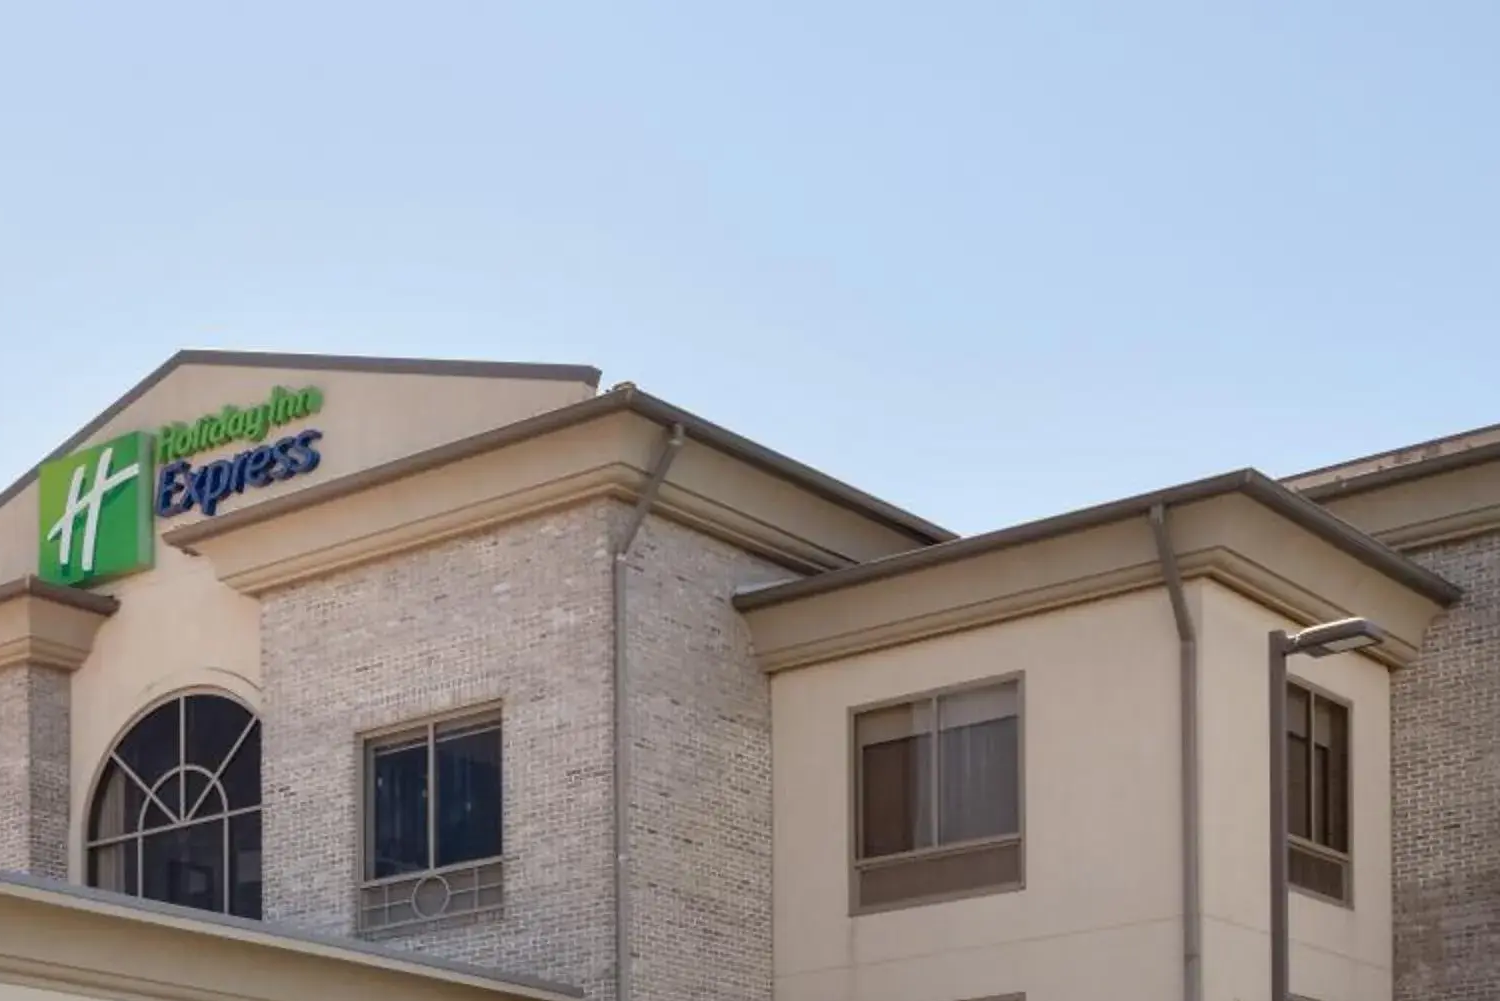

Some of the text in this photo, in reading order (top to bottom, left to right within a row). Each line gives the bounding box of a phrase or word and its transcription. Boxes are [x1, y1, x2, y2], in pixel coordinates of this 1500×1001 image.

[157, 385, 323, 464] Holiday Inn
[47, 447, 140, 571] H
[156, 429, 323, 517] Express
